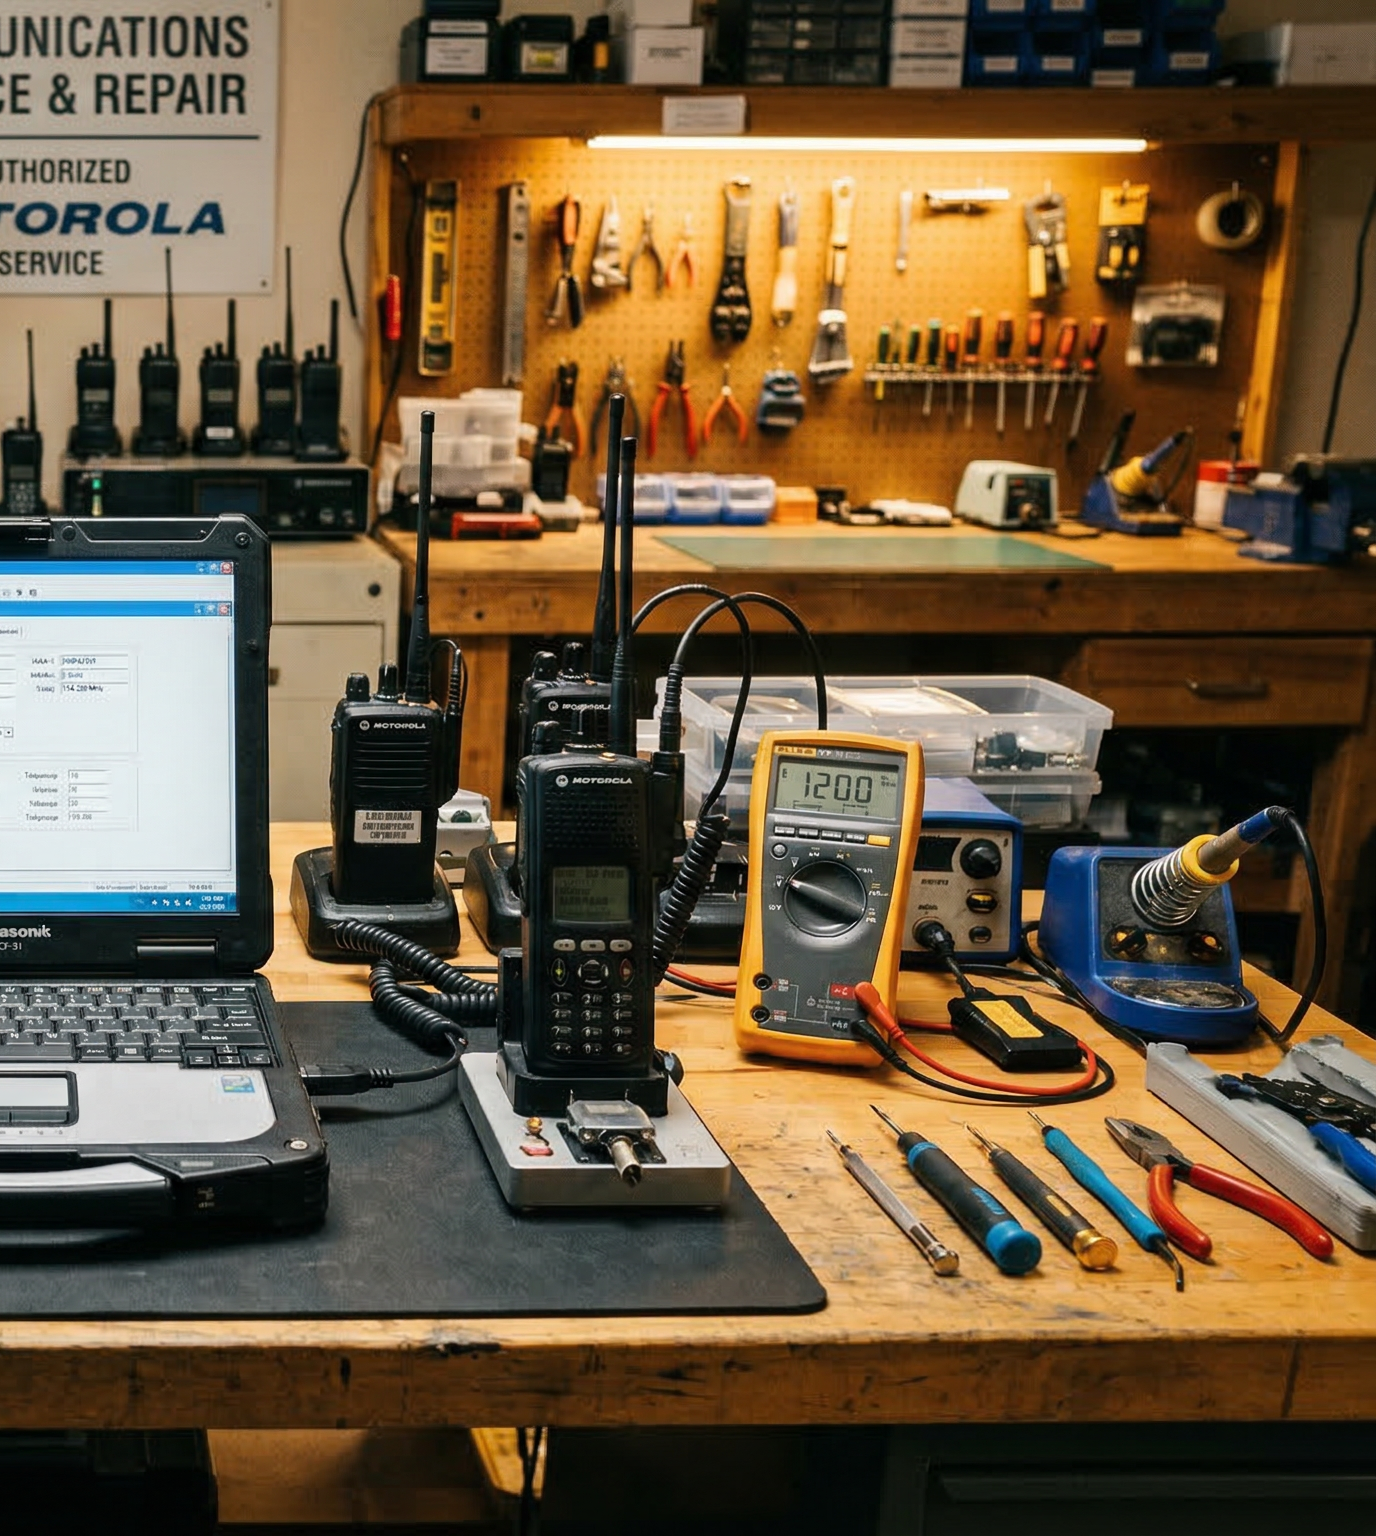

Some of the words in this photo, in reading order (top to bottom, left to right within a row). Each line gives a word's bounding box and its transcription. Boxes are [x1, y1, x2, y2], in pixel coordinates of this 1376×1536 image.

[48, 73, 77, 116] &
[94, 73, 247, 115] REPAIR
[803, 770, 873, 804] 1200
